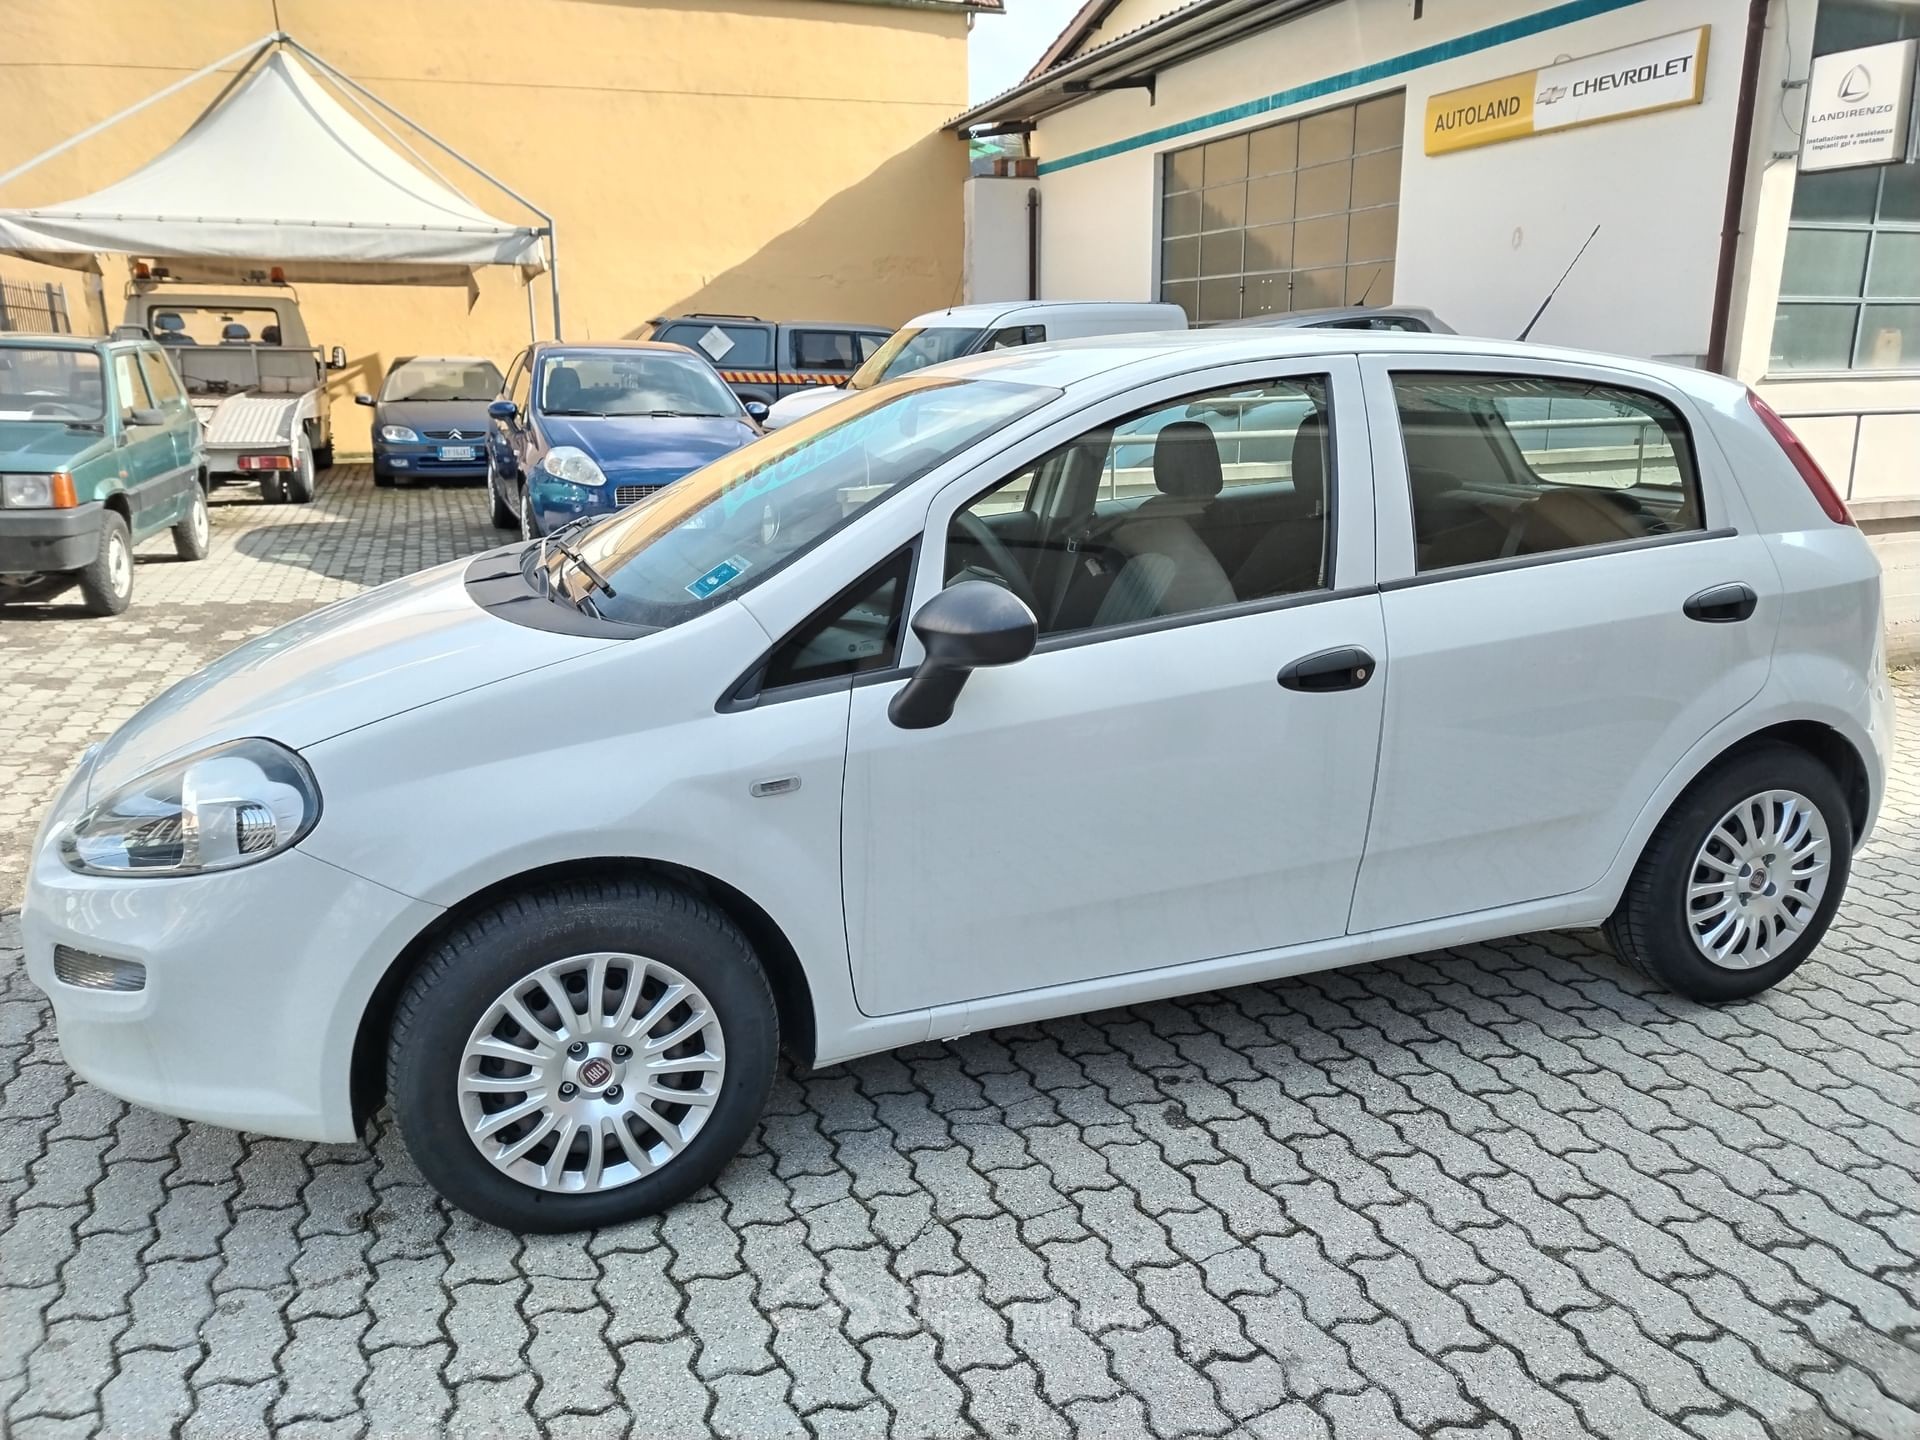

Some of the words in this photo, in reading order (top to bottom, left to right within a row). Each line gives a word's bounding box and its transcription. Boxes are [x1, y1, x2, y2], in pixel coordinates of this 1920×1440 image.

[1572, 55, 1693, 98] CHEVROLET
[1434, 96, 1520, 132] AUTOLAND
[1811, 104, 1893, 123] LANDIRENZO
[1840, 140, 1851, 149] gpl
[586, 1064, 606, 1083] FIAT
